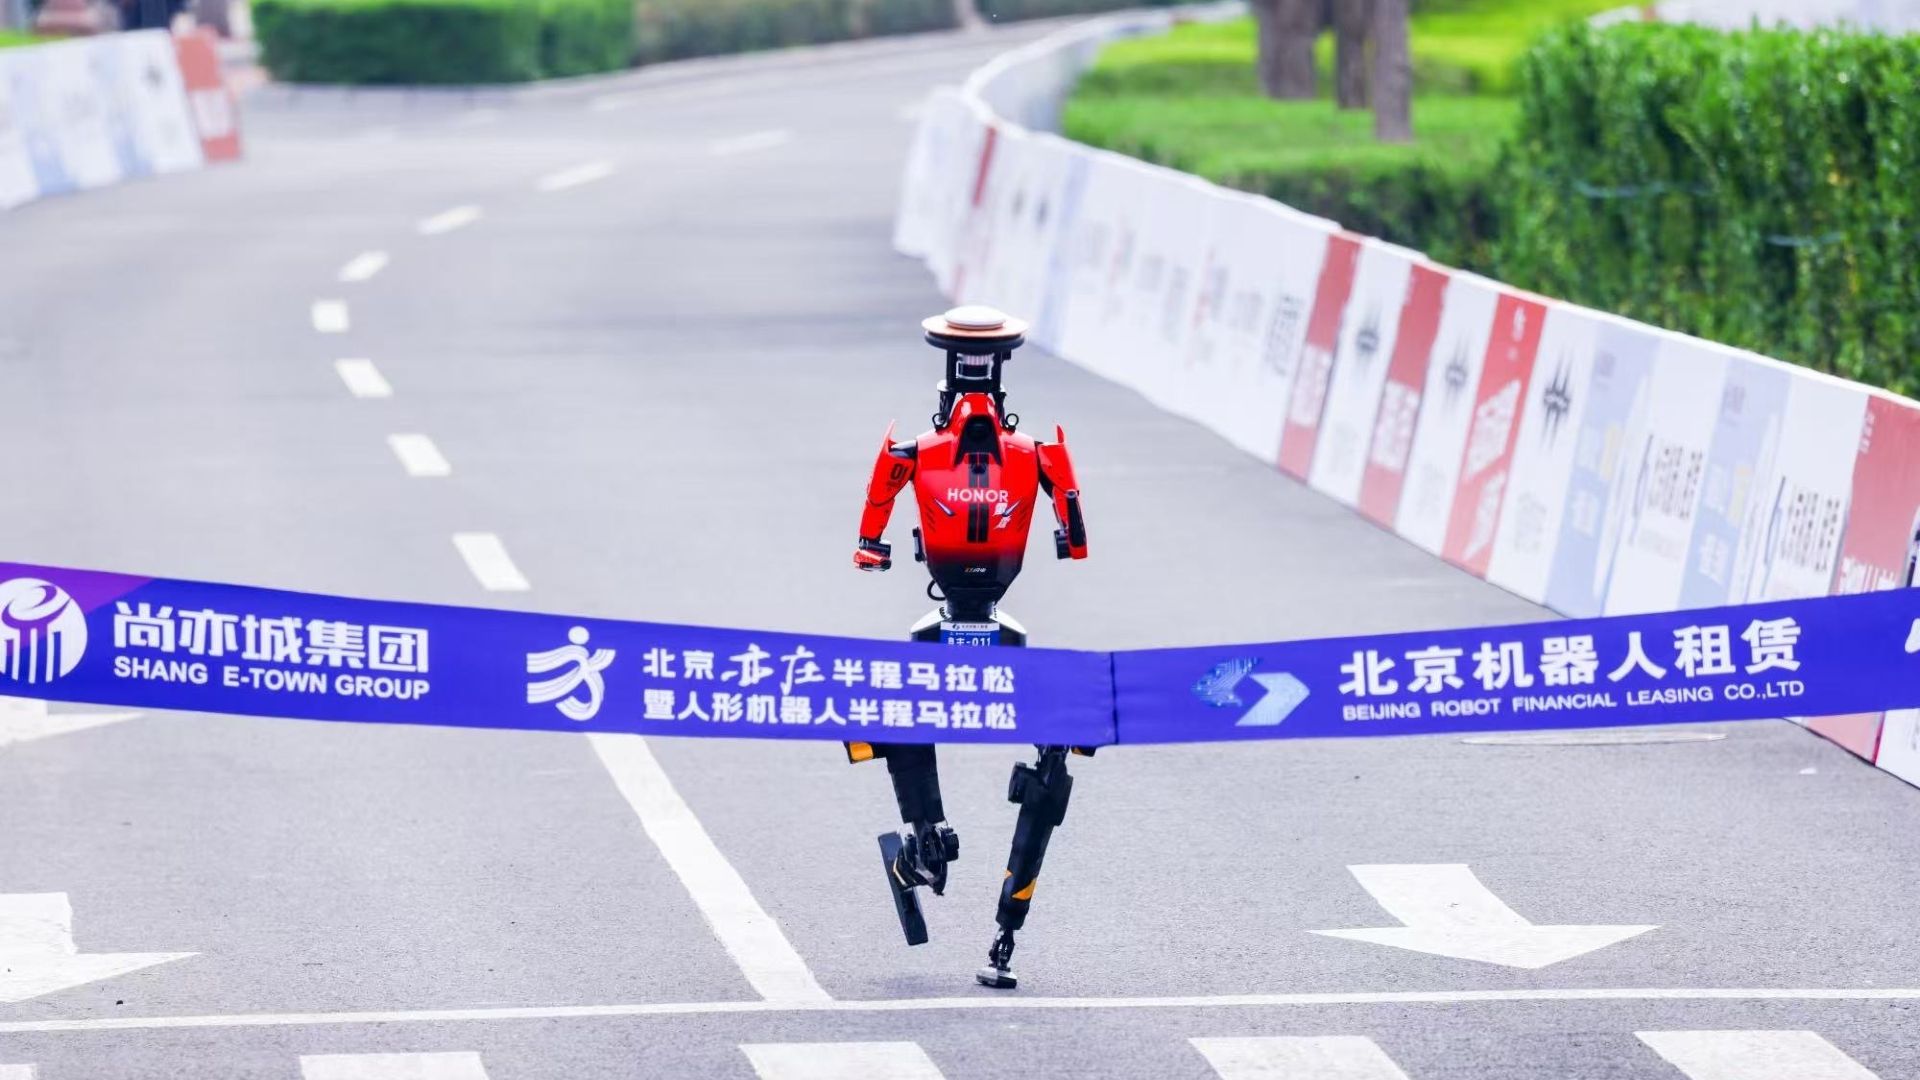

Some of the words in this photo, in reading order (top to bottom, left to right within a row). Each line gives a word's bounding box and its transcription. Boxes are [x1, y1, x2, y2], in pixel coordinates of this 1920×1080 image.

[947, 487, 1009, 503] HONOR
[113, 600, 429, 673] 尚亦城集团
[1338, 617, 1802, 697] 北京机器人租赁
[114, 655, 208, 685] SHANG
[223, 665, 327, 694] E-TOWN
[335, 674, 430, 700] GROUP
[643, 688, 1017, 730] 暨人形机器人半程马拉松
[1342, 702, 1421, 721] BEIJING
[1431, 698, 1501, 717] ROBOT
[1512, 693, 1618, 713] FINANCIAL
[1626, 687, 1714, 706] LEASING
[1724, 680, 1804, 700] CO.,LTD
